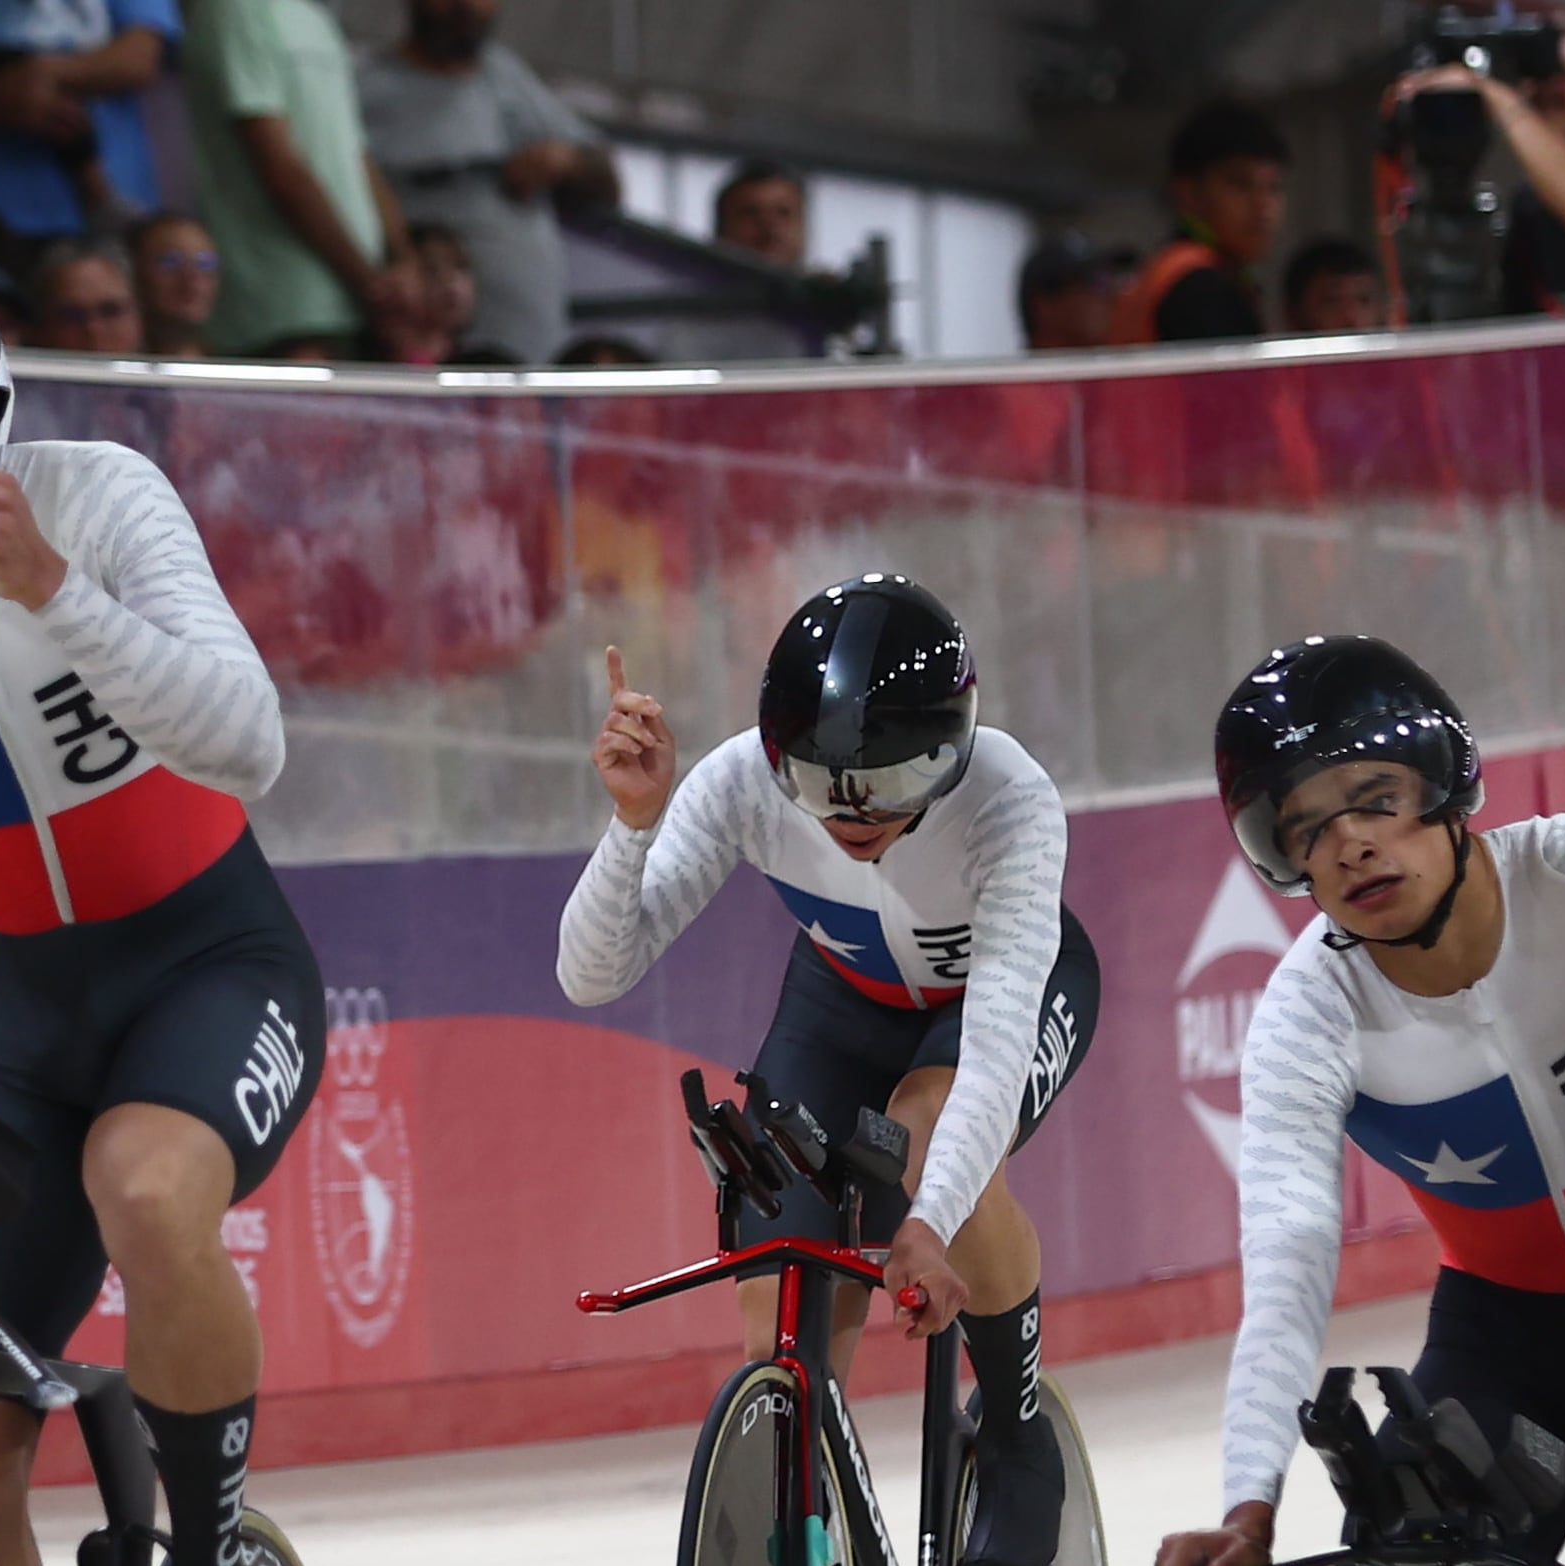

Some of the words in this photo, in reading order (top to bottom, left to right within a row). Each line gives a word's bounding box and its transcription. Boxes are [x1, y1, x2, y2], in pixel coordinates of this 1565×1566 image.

[34, 671, 140, 785] CHI
[1274, 722, 1319, 751] MET
[234, 999, 305, 1147] CHILE
[1031, 991, 1076, 1121] CHILE
